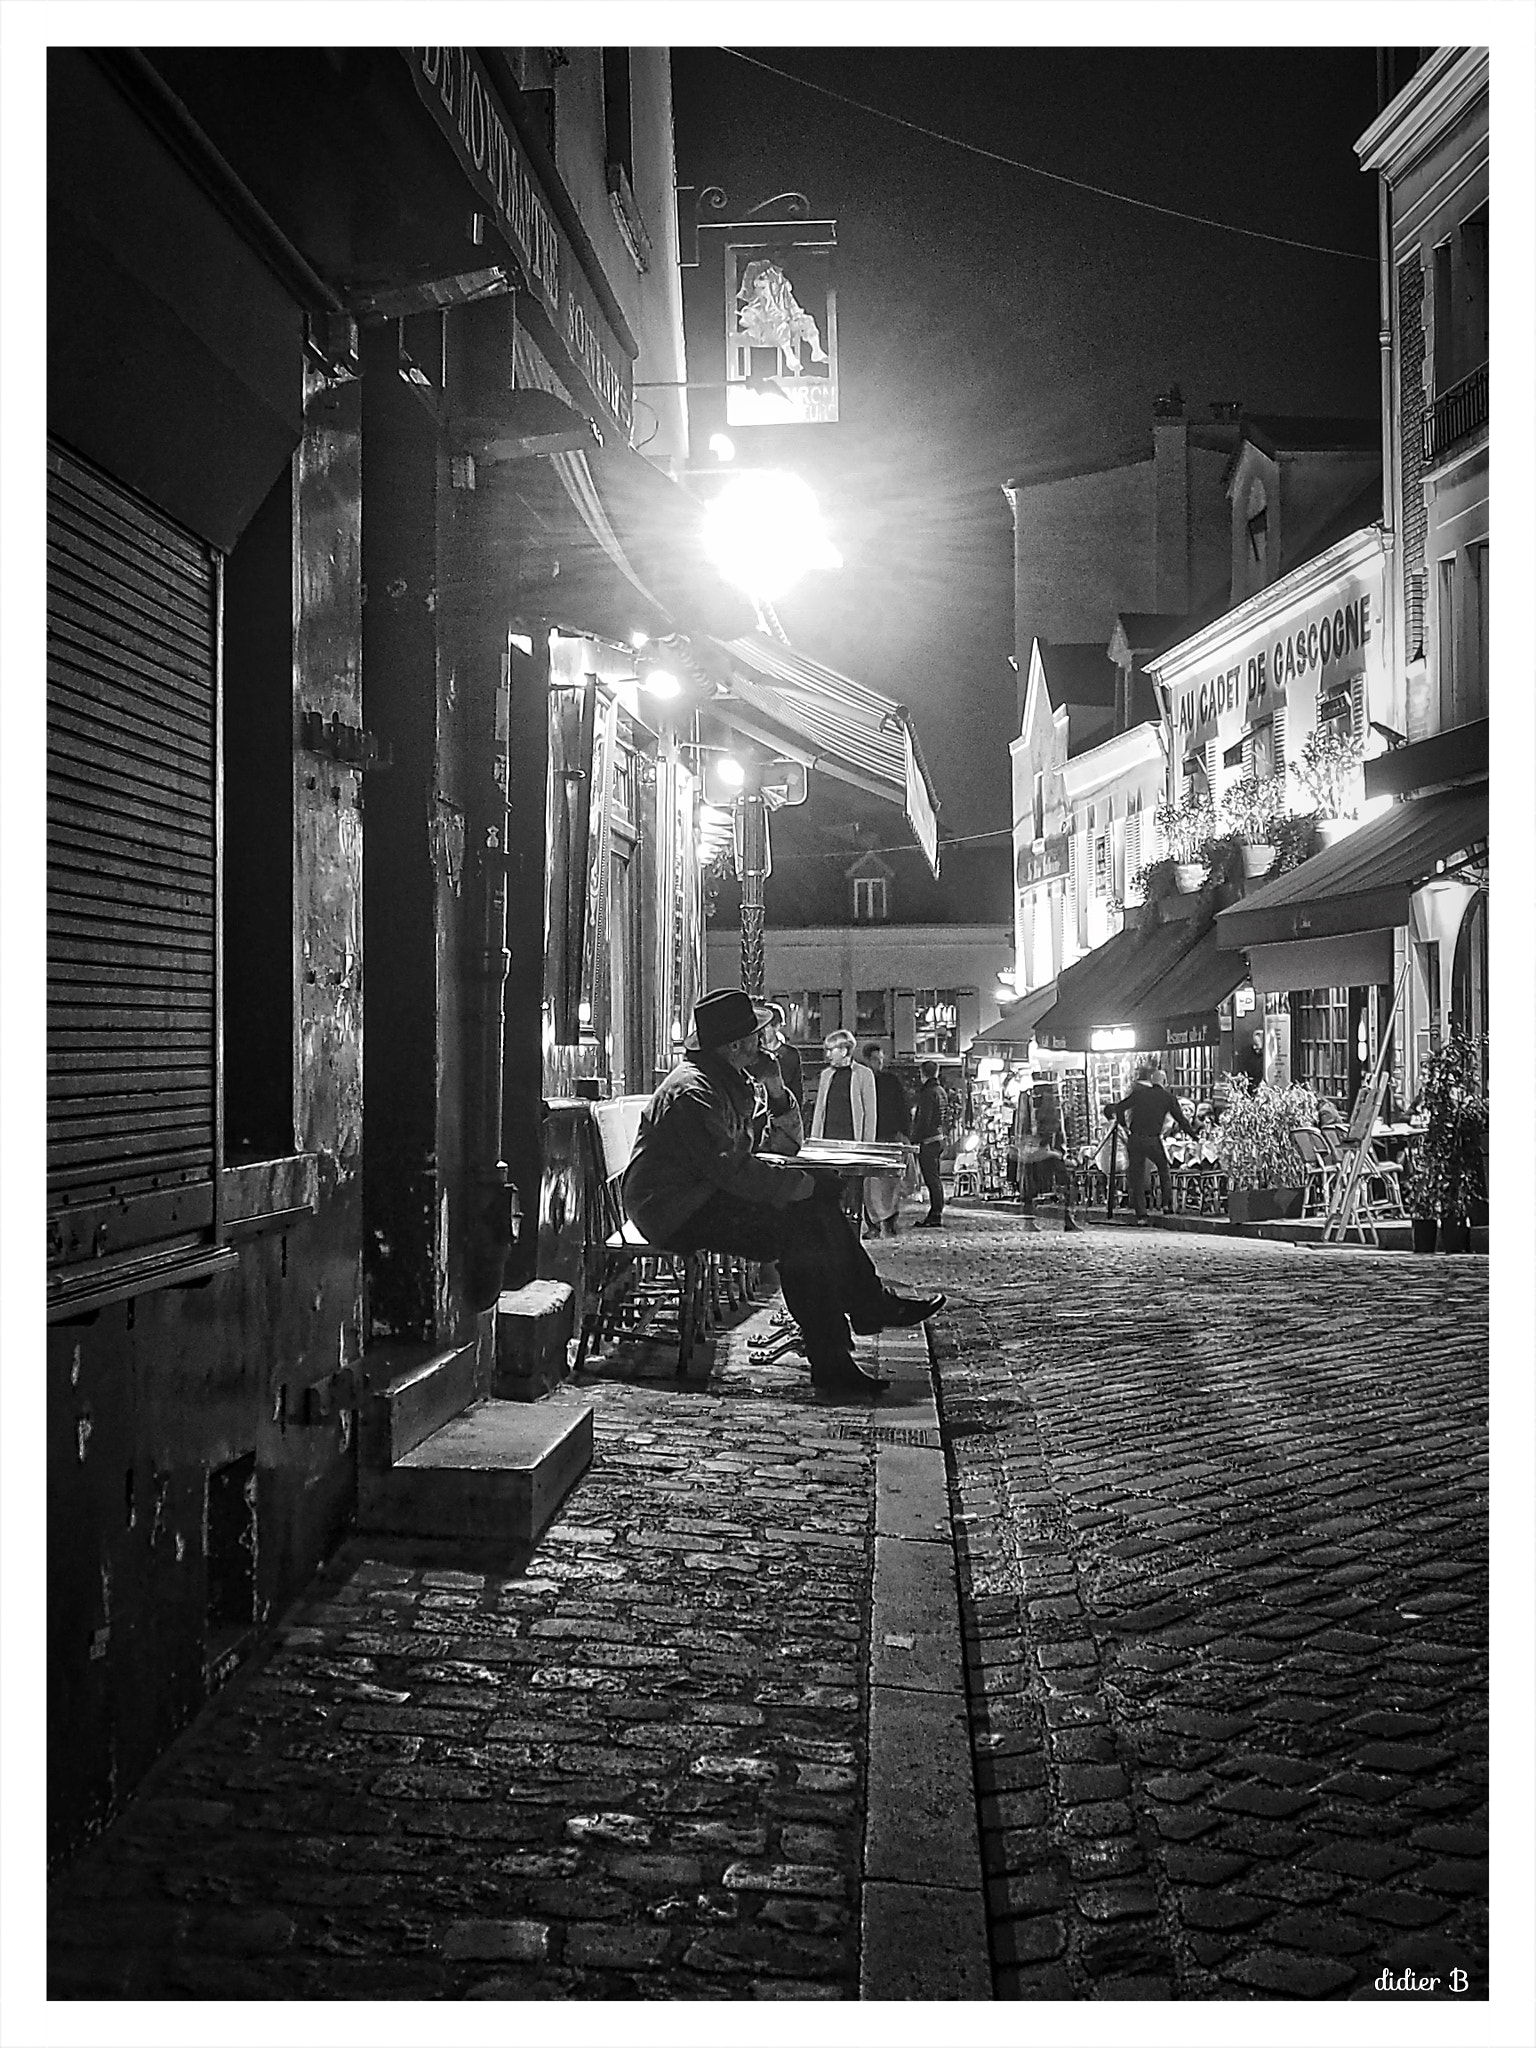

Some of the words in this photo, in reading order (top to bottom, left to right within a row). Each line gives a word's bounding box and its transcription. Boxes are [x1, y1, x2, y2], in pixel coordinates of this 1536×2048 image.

[1179, 689, 1196, 735] AU
[1200, 664, 1242, 725] CADET
[1247, 650, 1267, 702] DE
[1273, 593, 1372, 688] GASCOGNE
